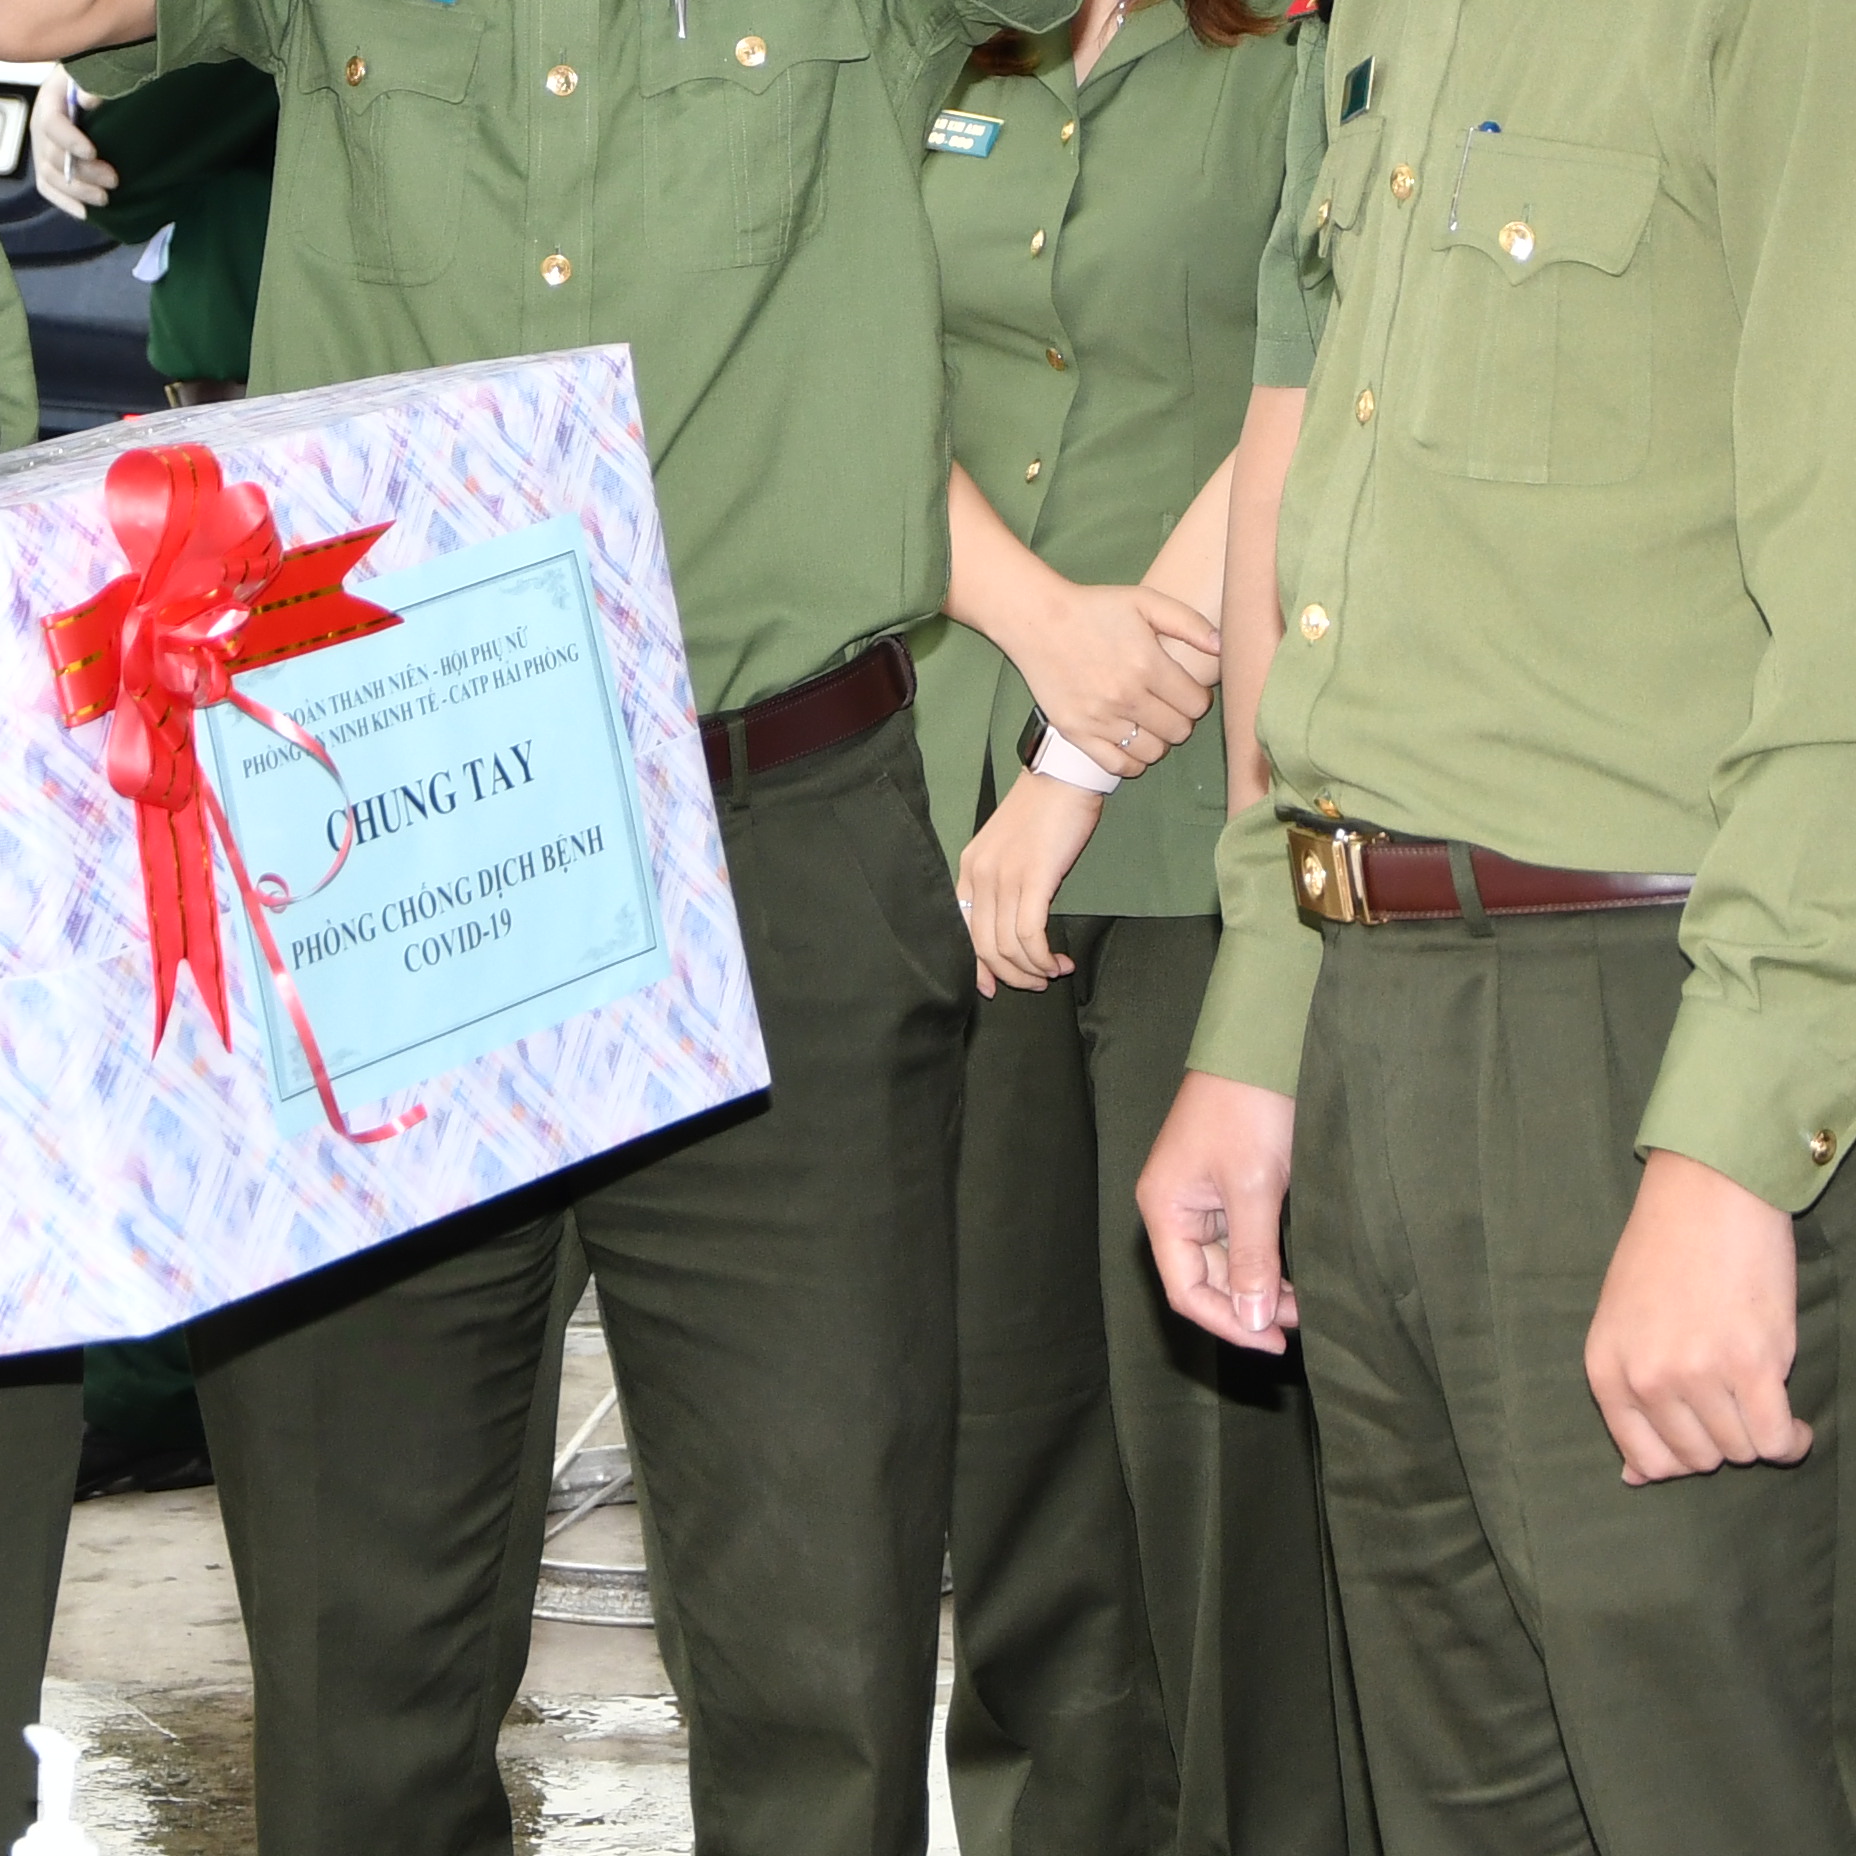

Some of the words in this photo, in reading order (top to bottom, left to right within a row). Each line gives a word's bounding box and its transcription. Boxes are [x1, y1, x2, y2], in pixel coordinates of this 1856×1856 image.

[242, 742, 302, 779] PHÒNG
[328, 716, 370, 748] NINH
[371, 701, 414, 732] KINH
[415, 688, 440, 715] TẾ
[449, 671, 489, 705] CATP
[491, 659, 522, 690] HẢI
[523, 642, 580, 678] PHÒNG
[283, 696, 327, 729] ĐOÀN
[328, 678, 386, 717] THANH
[387, 662, 430, 695] NIÊN
[440, 651, 468, 678] HỘI
[471, 637, 503, 665] PHỤ
[505, 625, 529, 655] NỮ
[325, 770, 458, 852] CHUNG
[461, 739, 537, 803] TAY
[291, 912, 377, 971] PHÒNG
[381, 875, 474, 934] CHỐNG
[478, 856, 536, 899] DỊCH
[541, 825, 605, 873] BỆNH
[403, 906, 513, 973] COVID-19
